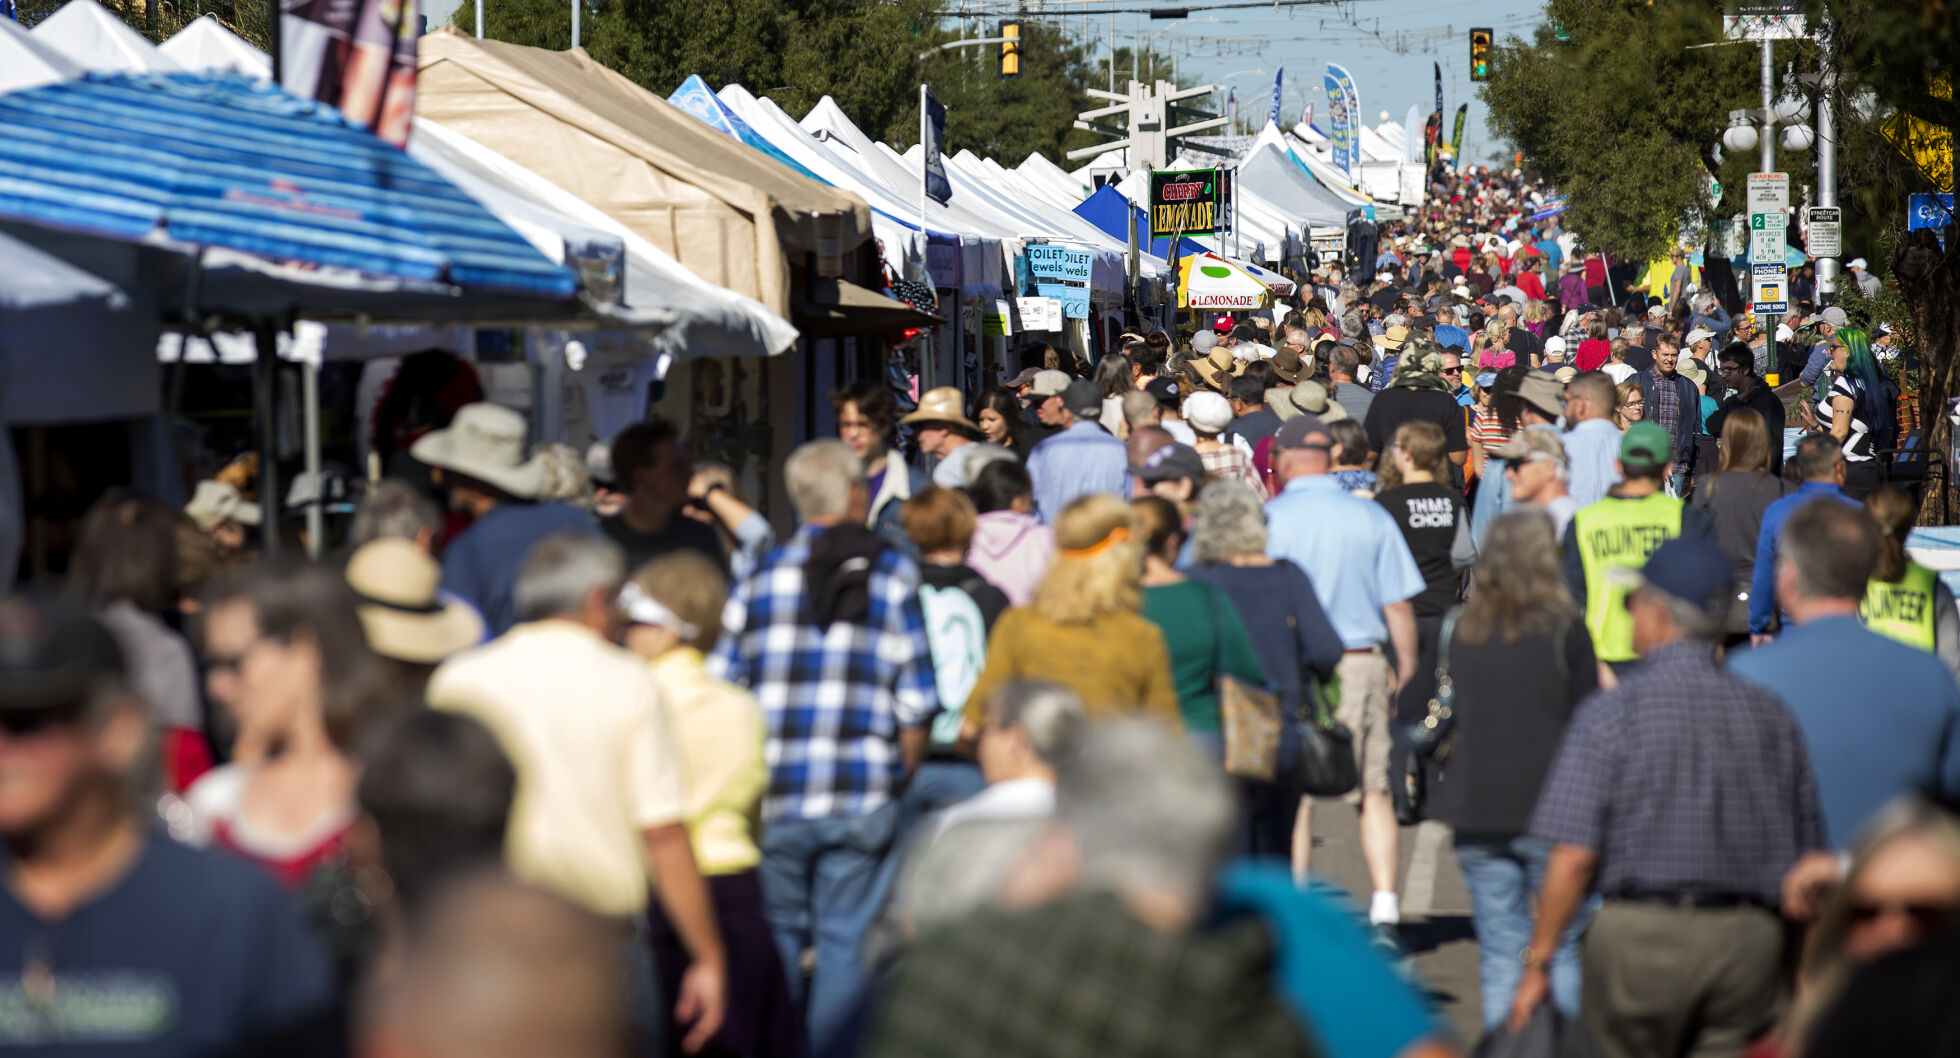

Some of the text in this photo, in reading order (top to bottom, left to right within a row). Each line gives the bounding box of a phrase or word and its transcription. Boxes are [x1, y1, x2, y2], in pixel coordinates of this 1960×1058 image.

[1163, 182, 1204, 200] CHERRY
[1153, 202, 1214, 232] LEMONADE
[1755, 216, 1762, 227] 2
[1027, 249, 1064, 259] TOILET
[1198, 296, 1253, 306] LEMONADE
[1406, 497, 1453, 513] THMS
[1408, 512, 1453, 528] CHOIR
